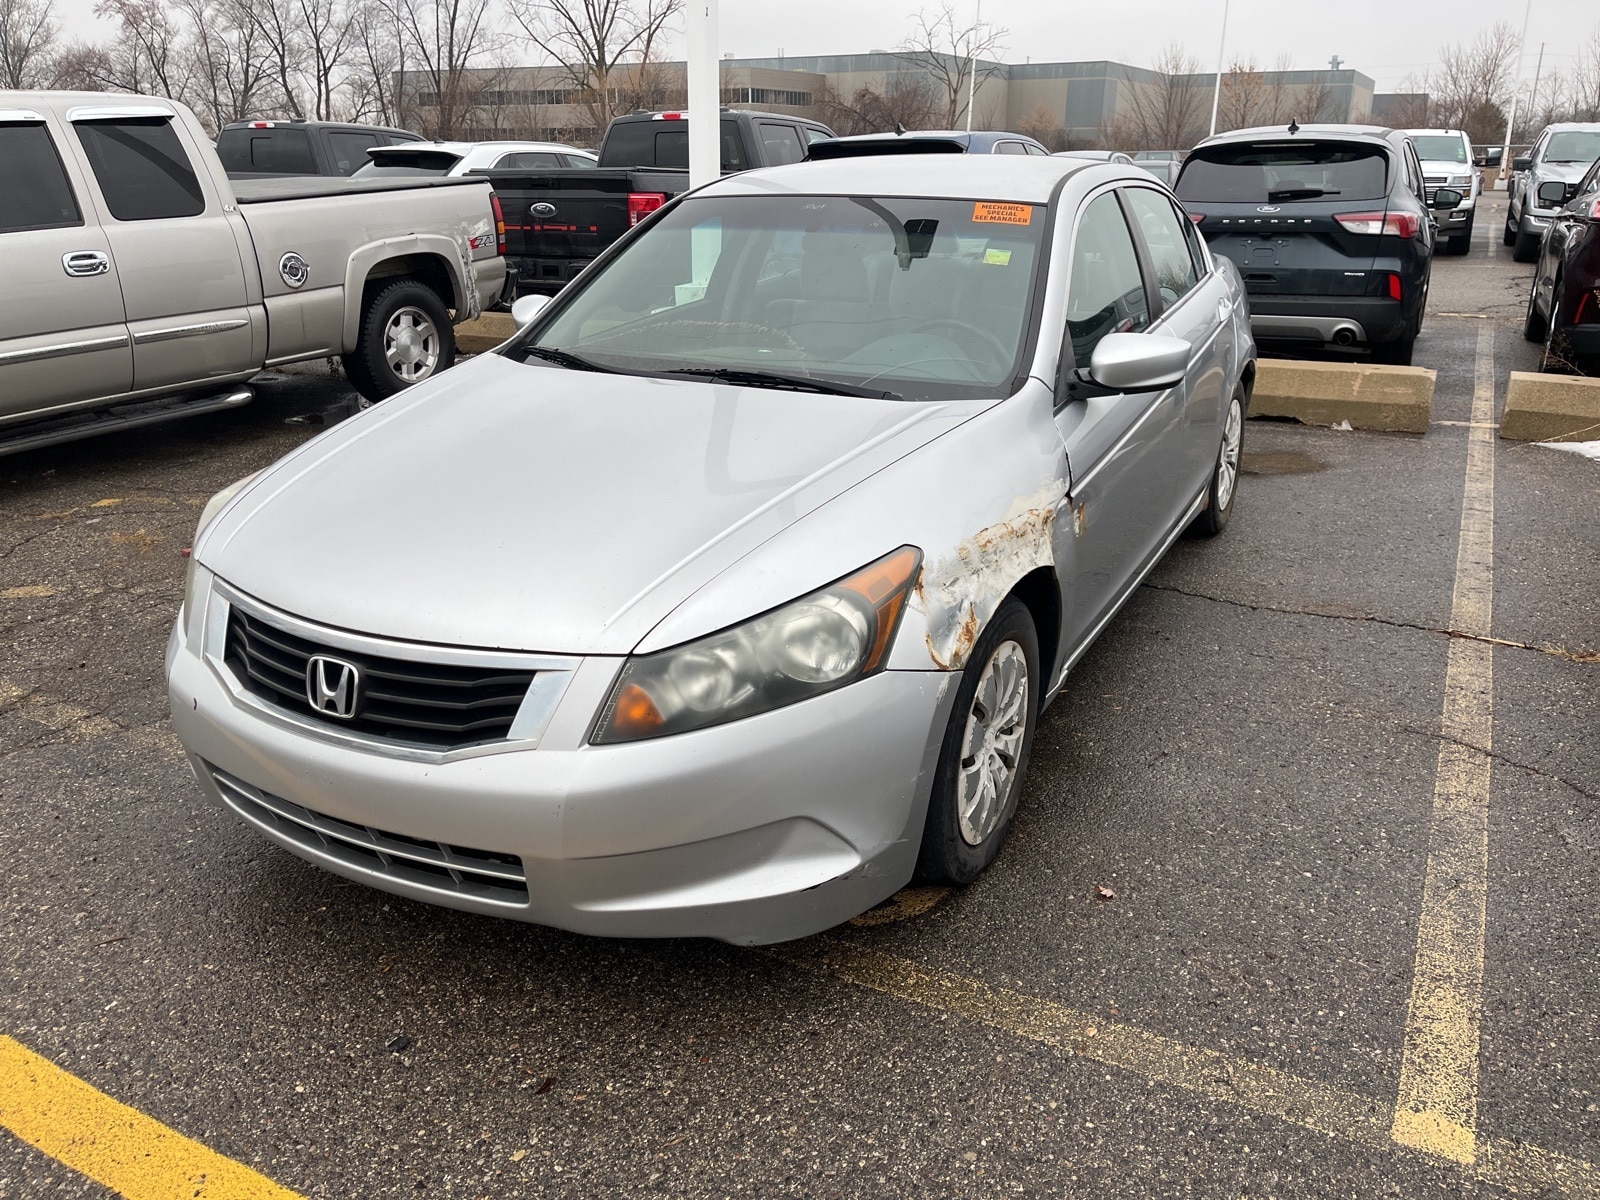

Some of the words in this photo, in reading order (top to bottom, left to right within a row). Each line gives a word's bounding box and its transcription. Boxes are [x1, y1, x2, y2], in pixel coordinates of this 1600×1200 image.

[981, 204, 1025, 212] MECHANICS
[986, 209, 1018, 217] SPECIAL
[989, 215, 1028, 224] MANAGER
